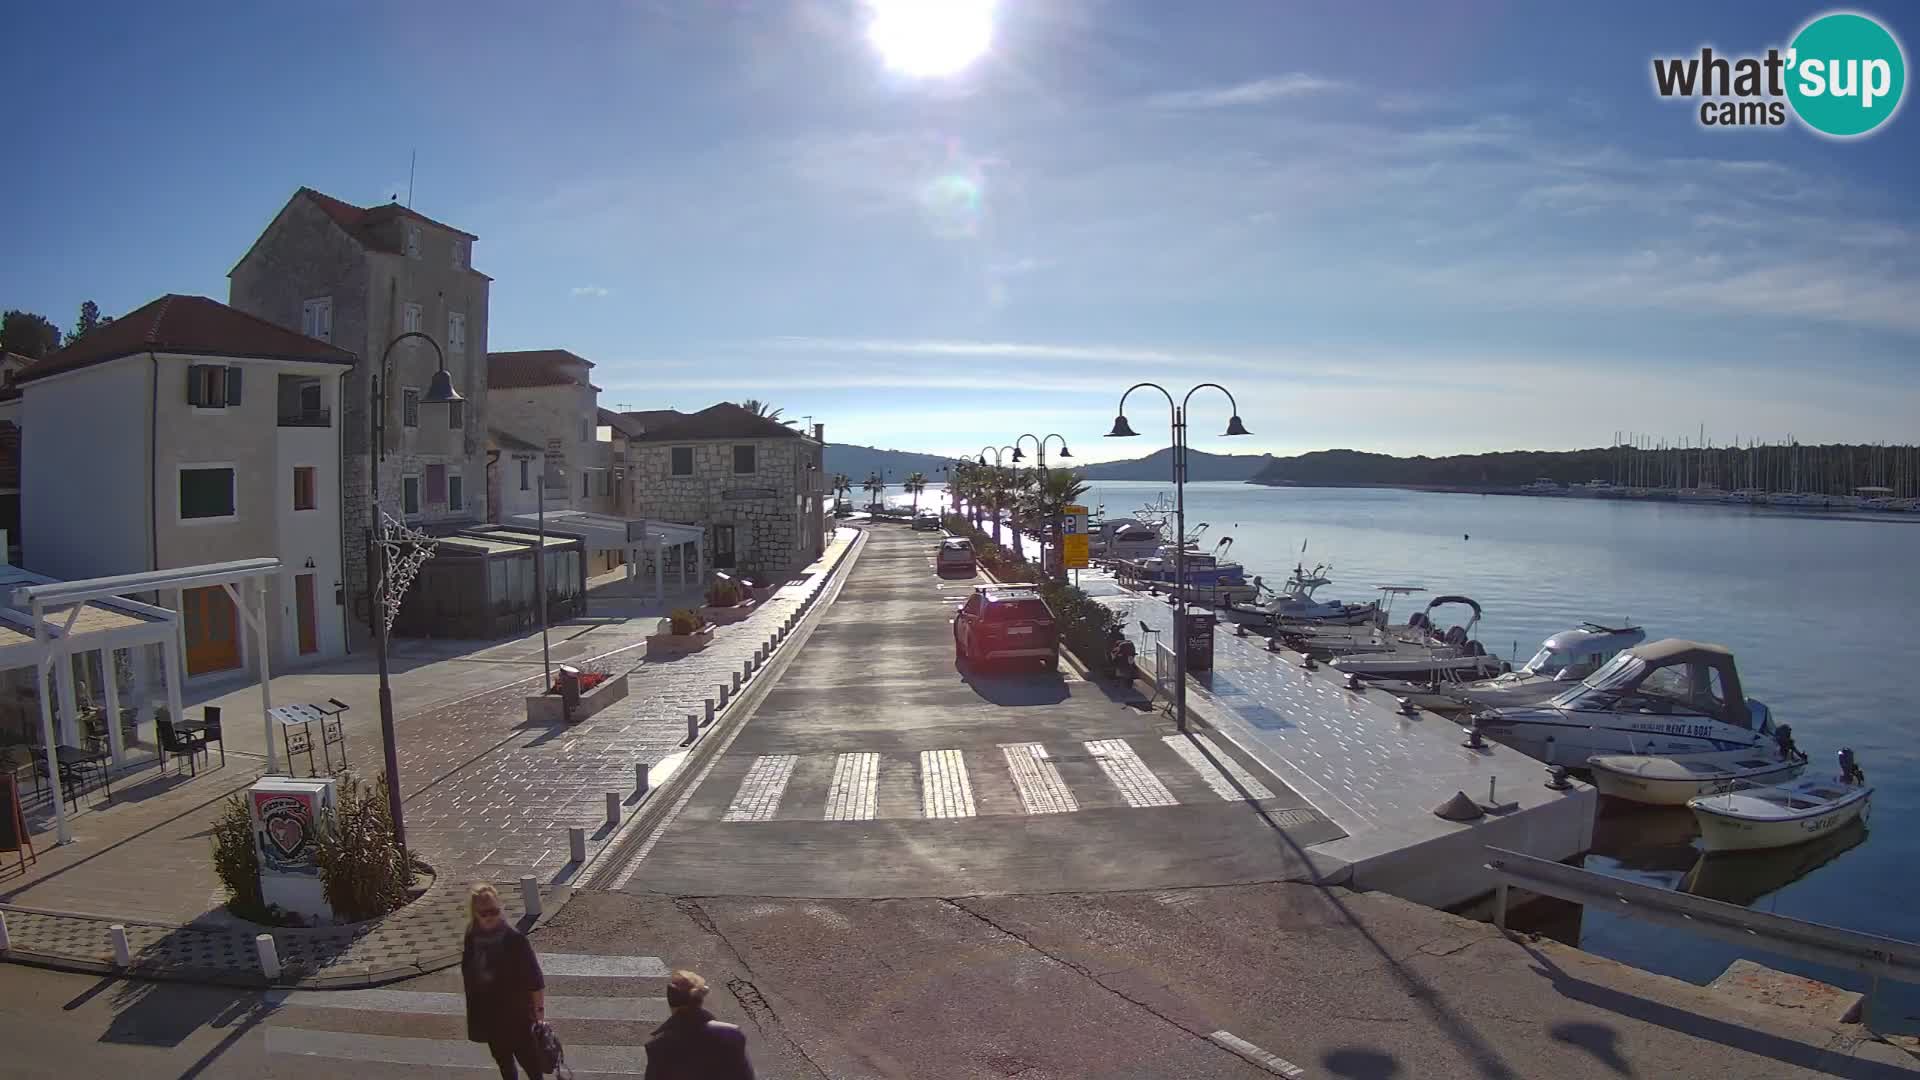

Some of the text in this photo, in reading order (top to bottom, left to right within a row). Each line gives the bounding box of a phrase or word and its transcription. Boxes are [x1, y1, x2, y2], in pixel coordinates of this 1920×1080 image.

[1064, 516, 1076, 532] P
[1665, 723, 1686, 735] RENT
[1694, 725, 1713, 738] BOAT
